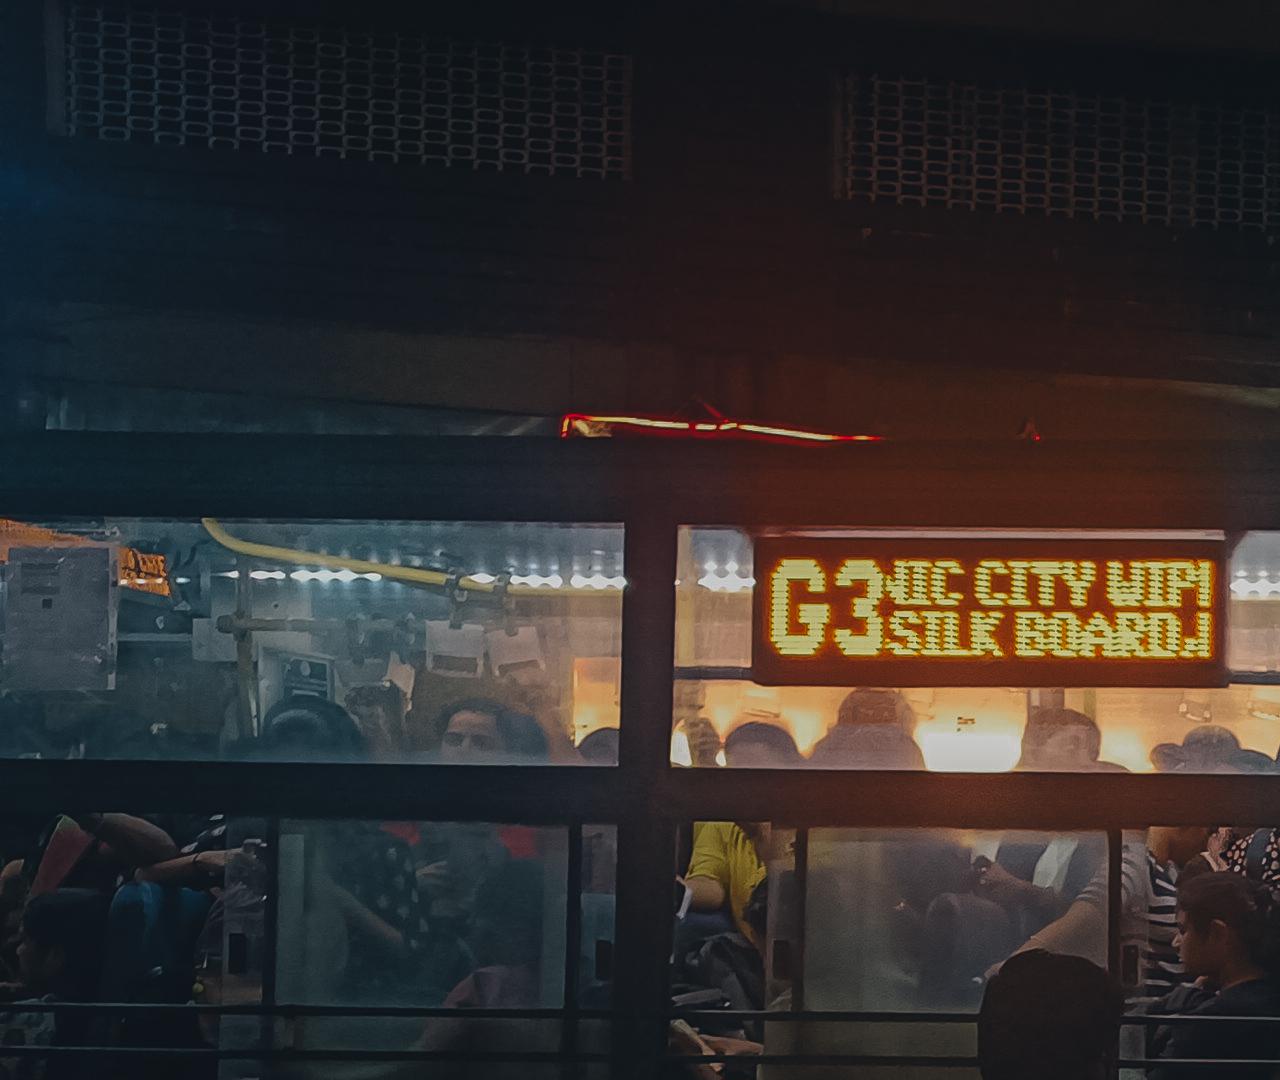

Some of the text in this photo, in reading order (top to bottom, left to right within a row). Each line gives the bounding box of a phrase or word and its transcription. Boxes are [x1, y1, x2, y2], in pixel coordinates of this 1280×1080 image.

[769, 558, 883, 656] G3
[974, 560, 1097, 608] CITY
[885, 610, 1004, 657] SILK
